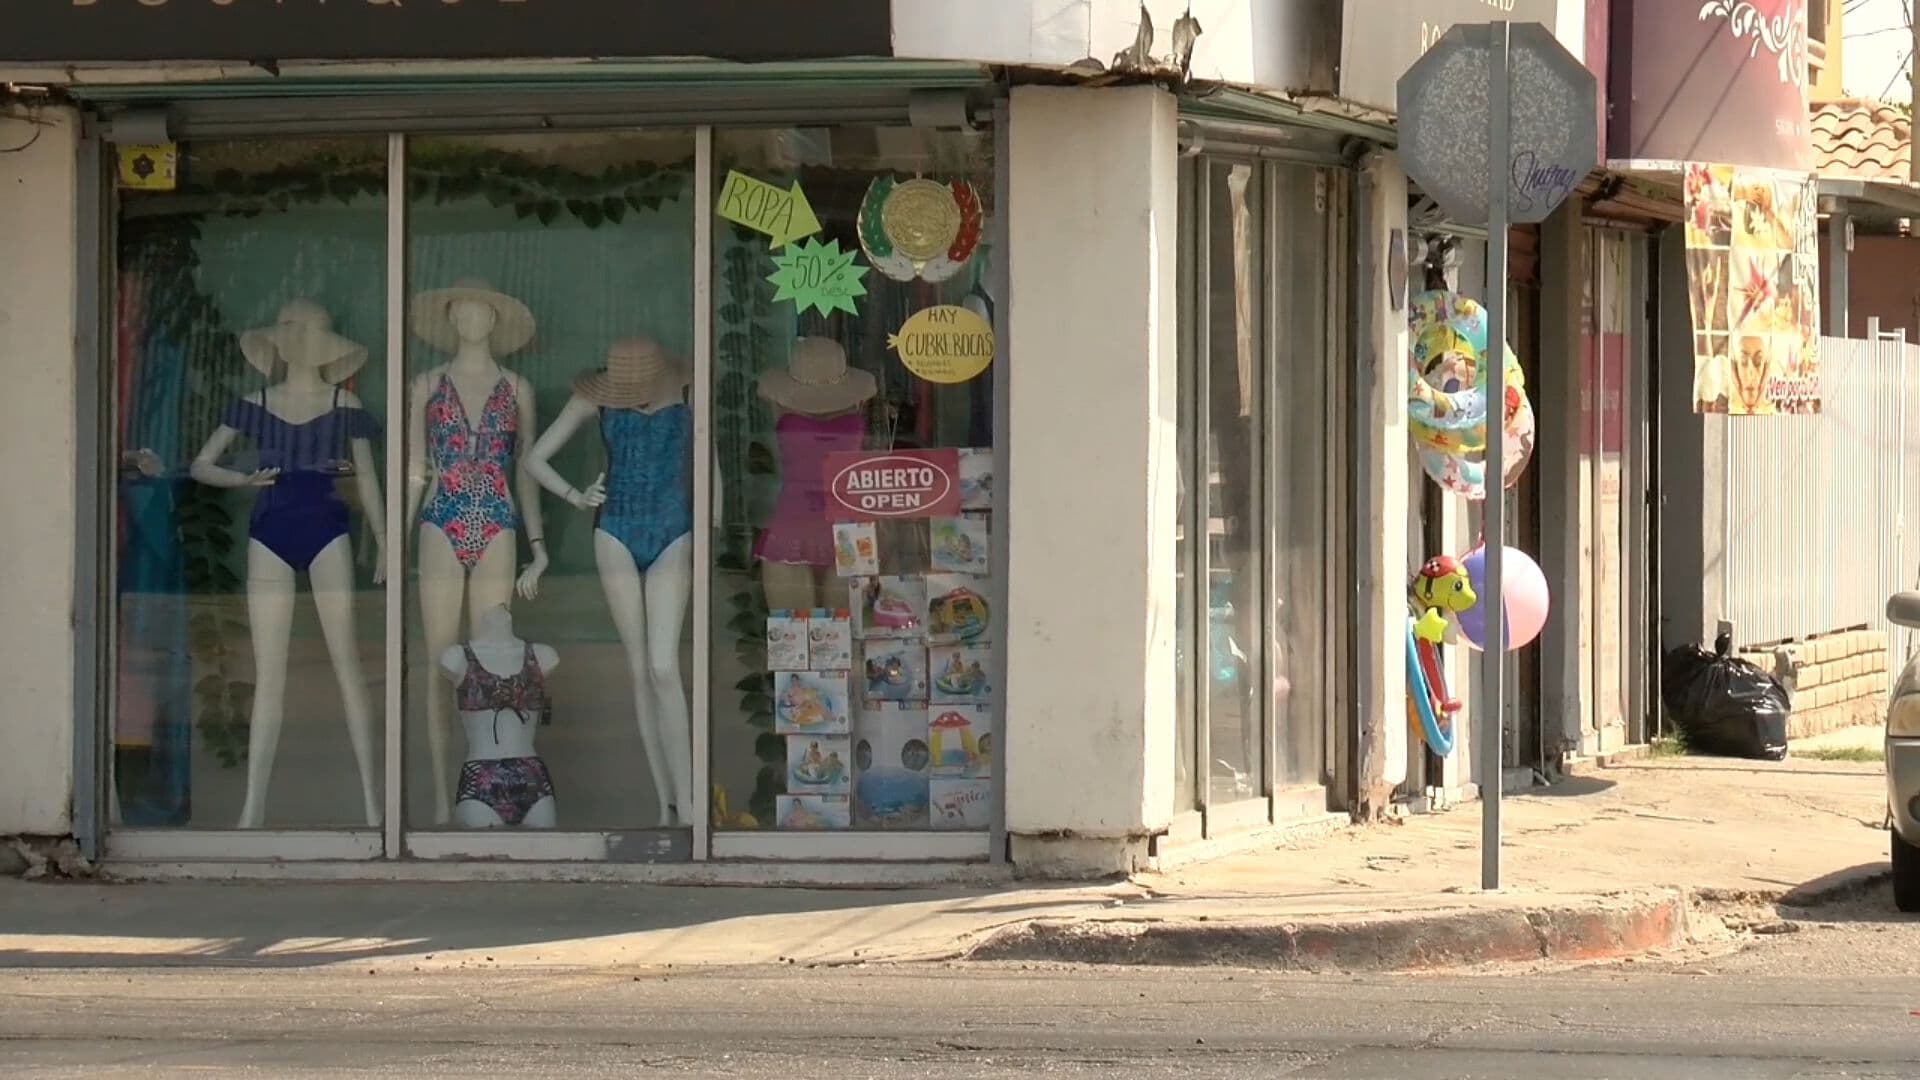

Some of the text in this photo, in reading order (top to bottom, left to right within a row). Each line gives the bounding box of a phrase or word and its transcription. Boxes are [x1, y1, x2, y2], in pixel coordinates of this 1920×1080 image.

[724, 177, 794, 234] ROPA
[781, 255, 850, 290] -50%
[928, 309, 958, 325] HAY
[847, 467, 933, 489] ABIERTO
[861, 493, 920, 509] OPEN
